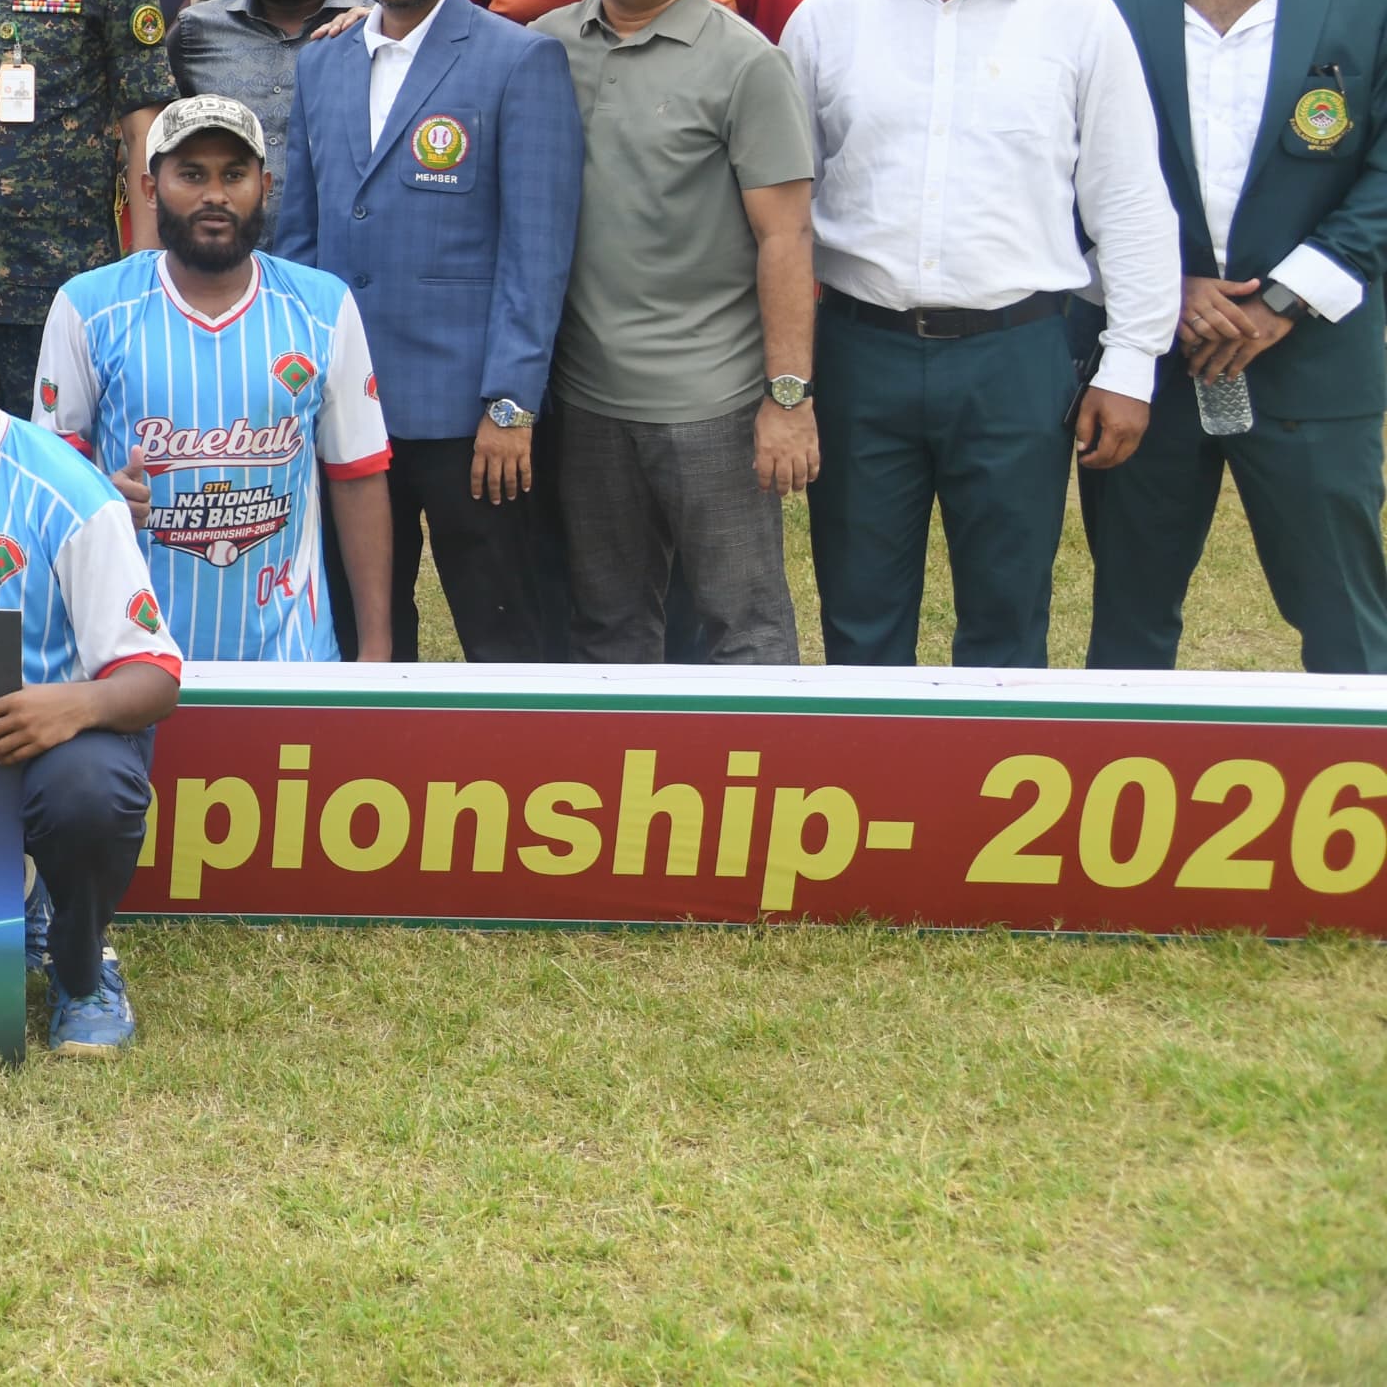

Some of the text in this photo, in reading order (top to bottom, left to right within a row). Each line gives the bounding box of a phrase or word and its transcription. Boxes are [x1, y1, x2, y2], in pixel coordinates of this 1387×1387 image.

[415, 173, 458, 184] MEMBER
[177, 486, 272, 508] NATIONAL
[204, 482, 231, 493] 9TH
[145, 495, 292, 529] MEN'S BASEBALL
[170, 522, 276, 542] CHAMPIONSHIP-2026
[255, 558, 294, 607] 04
[139, 743, 915, 911] pionship-
[964, 754, 1387, 895] 2026
